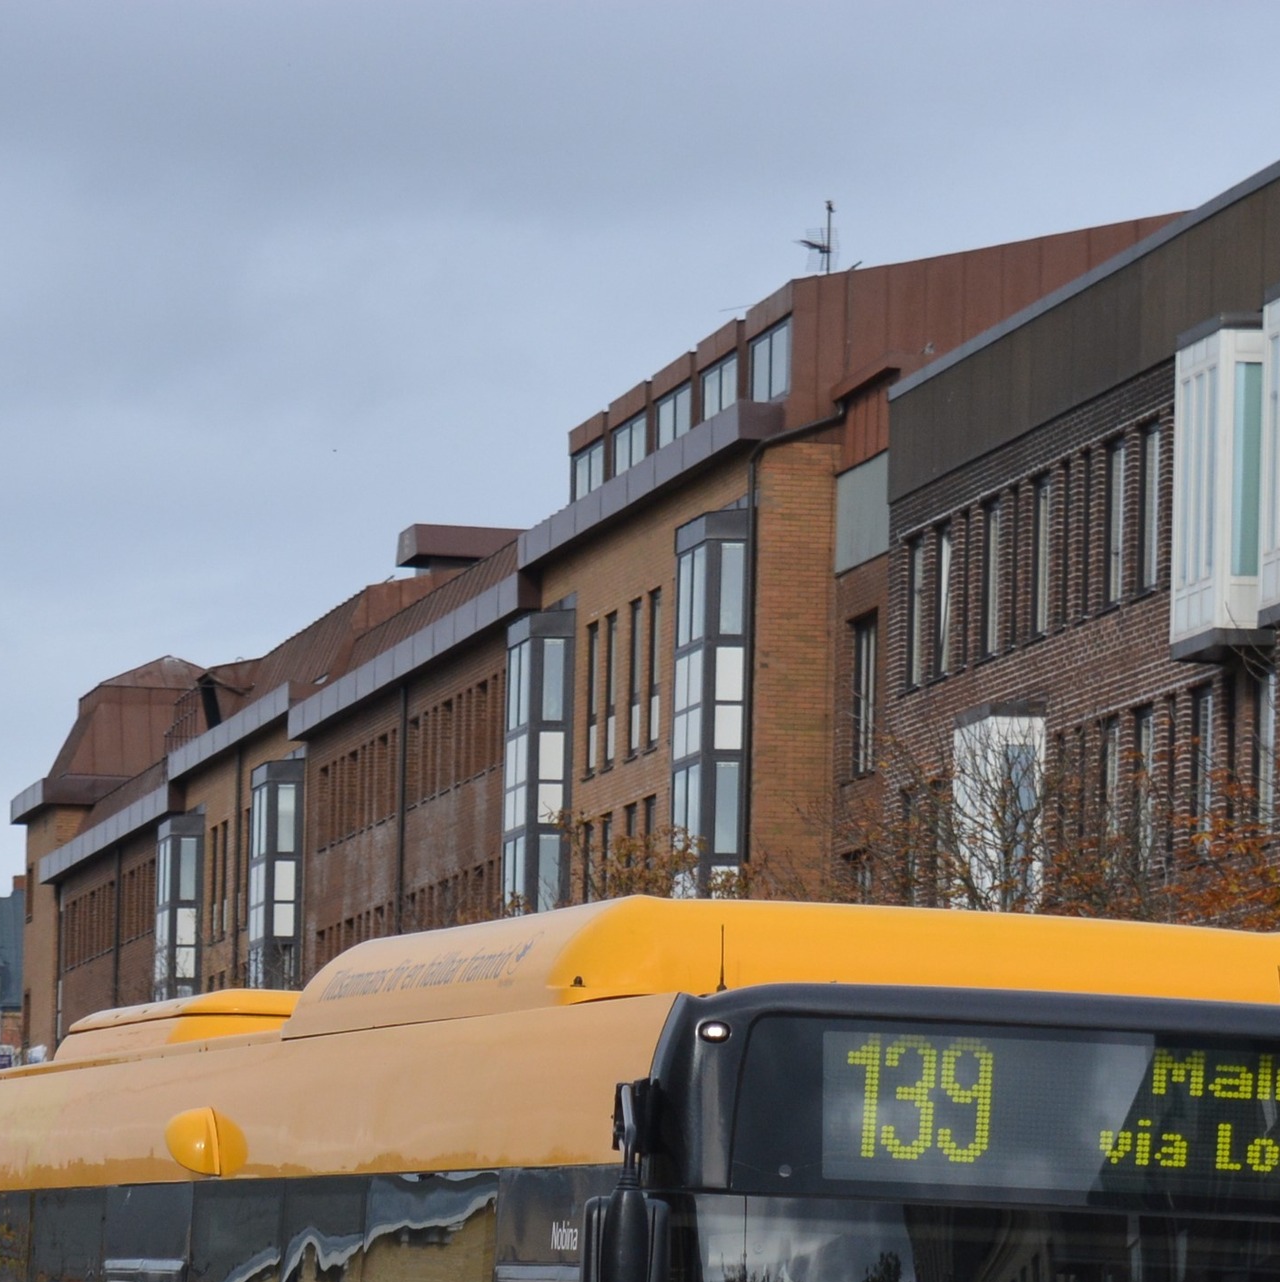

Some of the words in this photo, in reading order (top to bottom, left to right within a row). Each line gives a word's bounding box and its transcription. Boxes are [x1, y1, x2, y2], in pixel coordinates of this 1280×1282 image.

[846, 1033, 994, 1163] 139
[1099, 1119, 1188, 1167] via
[551, 1220, 578, 1250] Nobina
